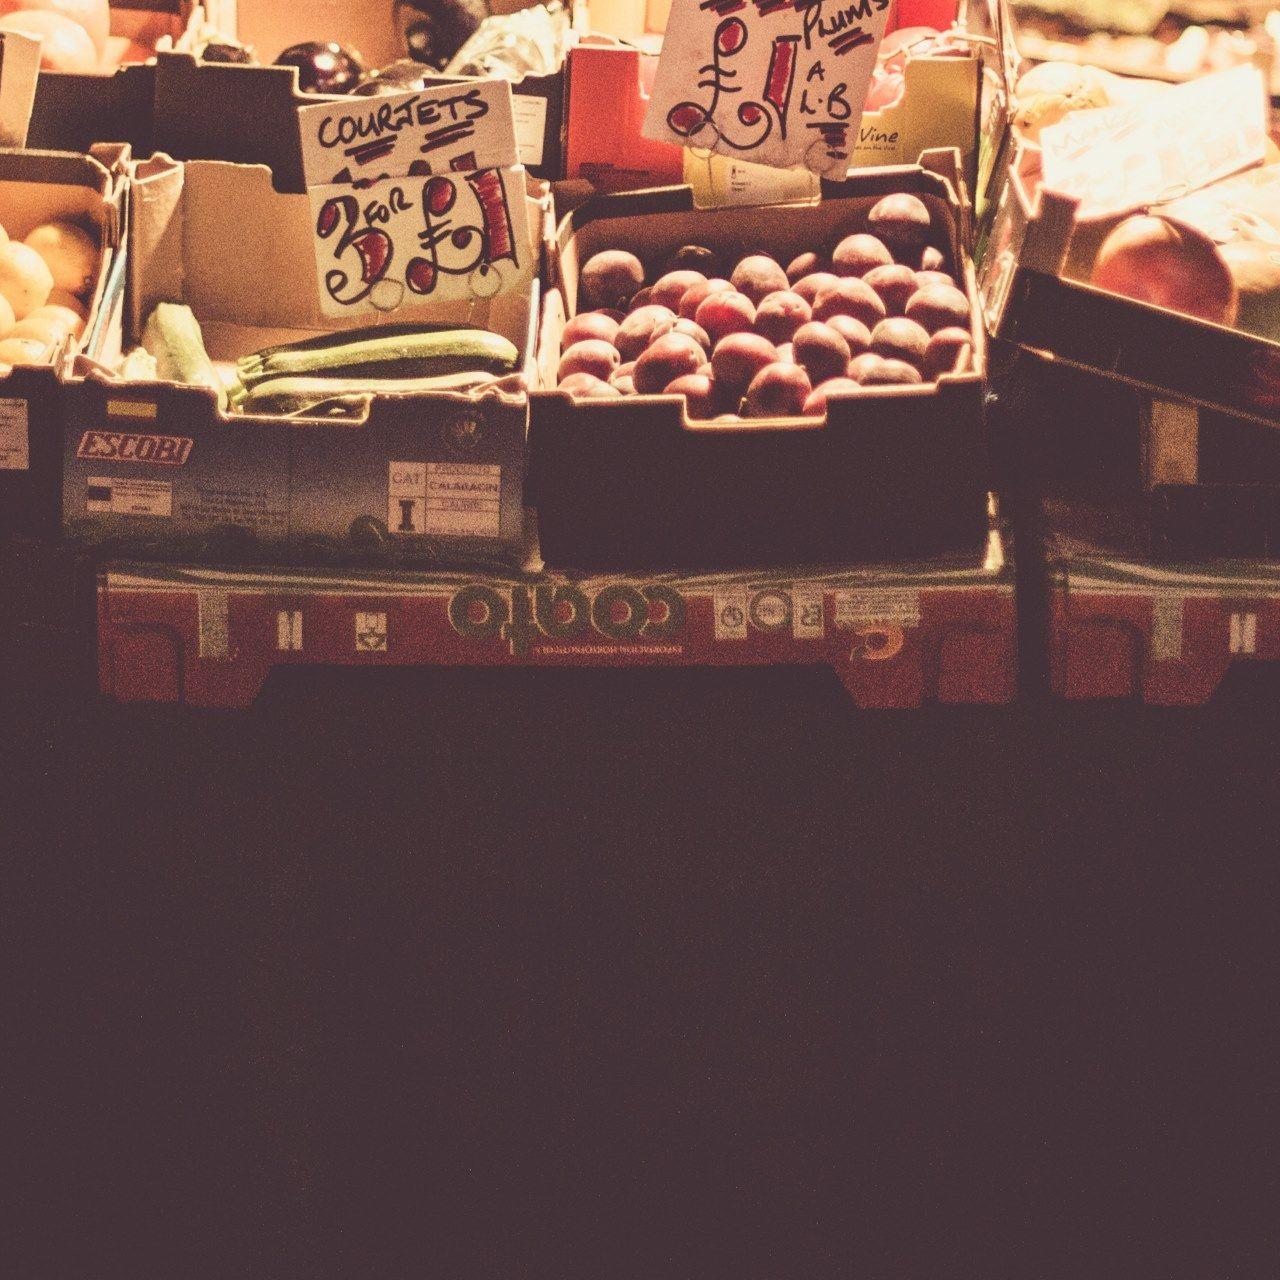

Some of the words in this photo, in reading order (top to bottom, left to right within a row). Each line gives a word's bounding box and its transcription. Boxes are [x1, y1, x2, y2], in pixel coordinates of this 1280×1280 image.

[667, 17, 802, 150] £1
[807, 60, 825, 81] A
[319, 90, 489, 148] COURJETS
[860, 126, 899, 143] Vine
[317, 195, 393, 305] 3
[364, 187, 414, 223] FOR
[406, 167, 520, 295] £1
[81, 432, 191, 463] ESCOBI
